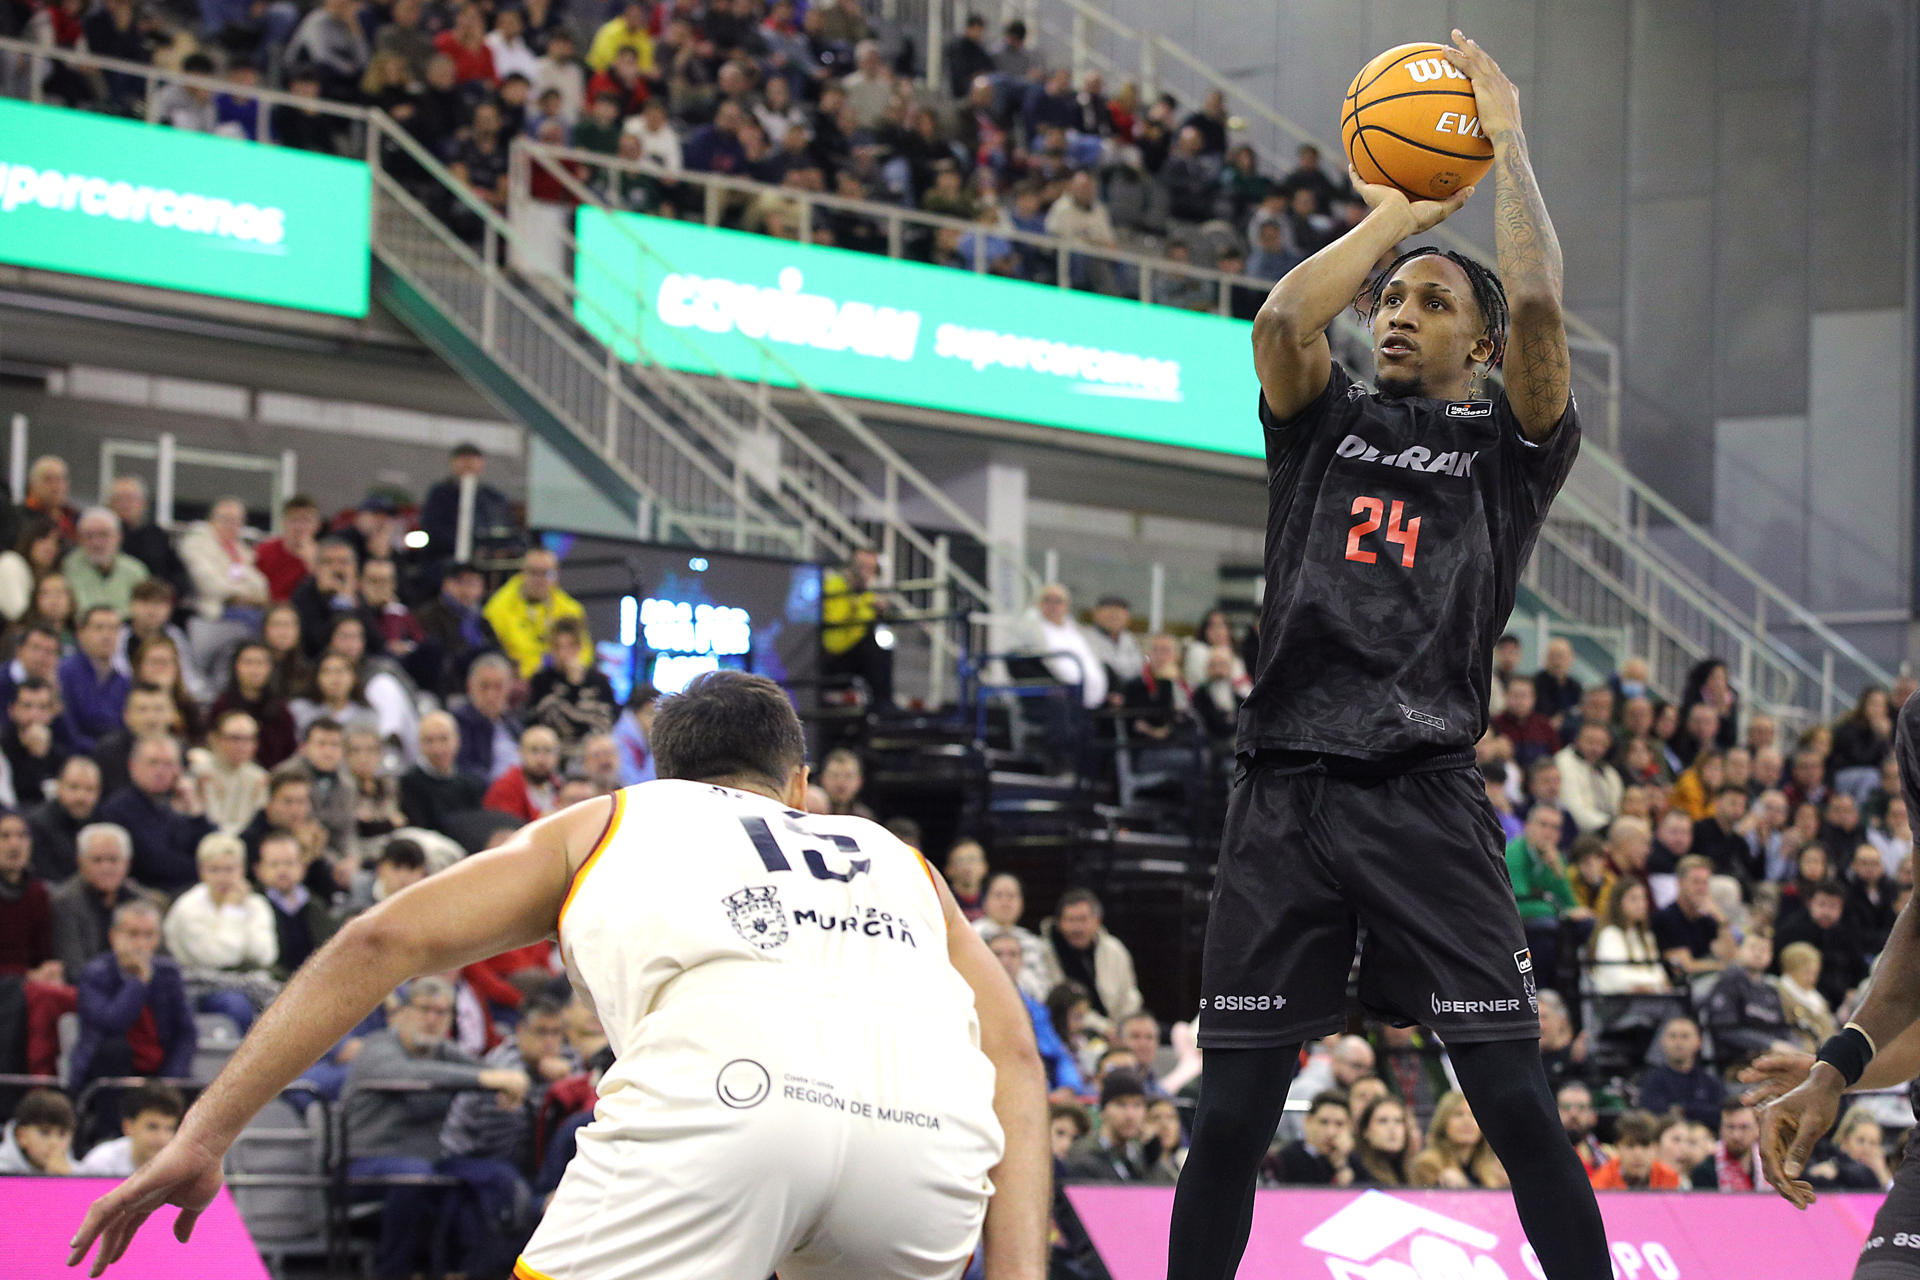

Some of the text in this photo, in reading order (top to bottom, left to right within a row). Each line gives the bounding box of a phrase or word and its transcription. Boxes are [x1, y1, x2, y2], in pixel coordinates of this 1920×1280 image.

[1345, 496, 1422, 568] 24
[1214, 995, 1270, 1011] asisa
[1442, 999, 1520, 1013] BERNER
[784, 1085, 845, 1111] REGIÓN
[850, 1101, 872, 1118] DE
[877, 1107, 940, 1130] MURCIA
